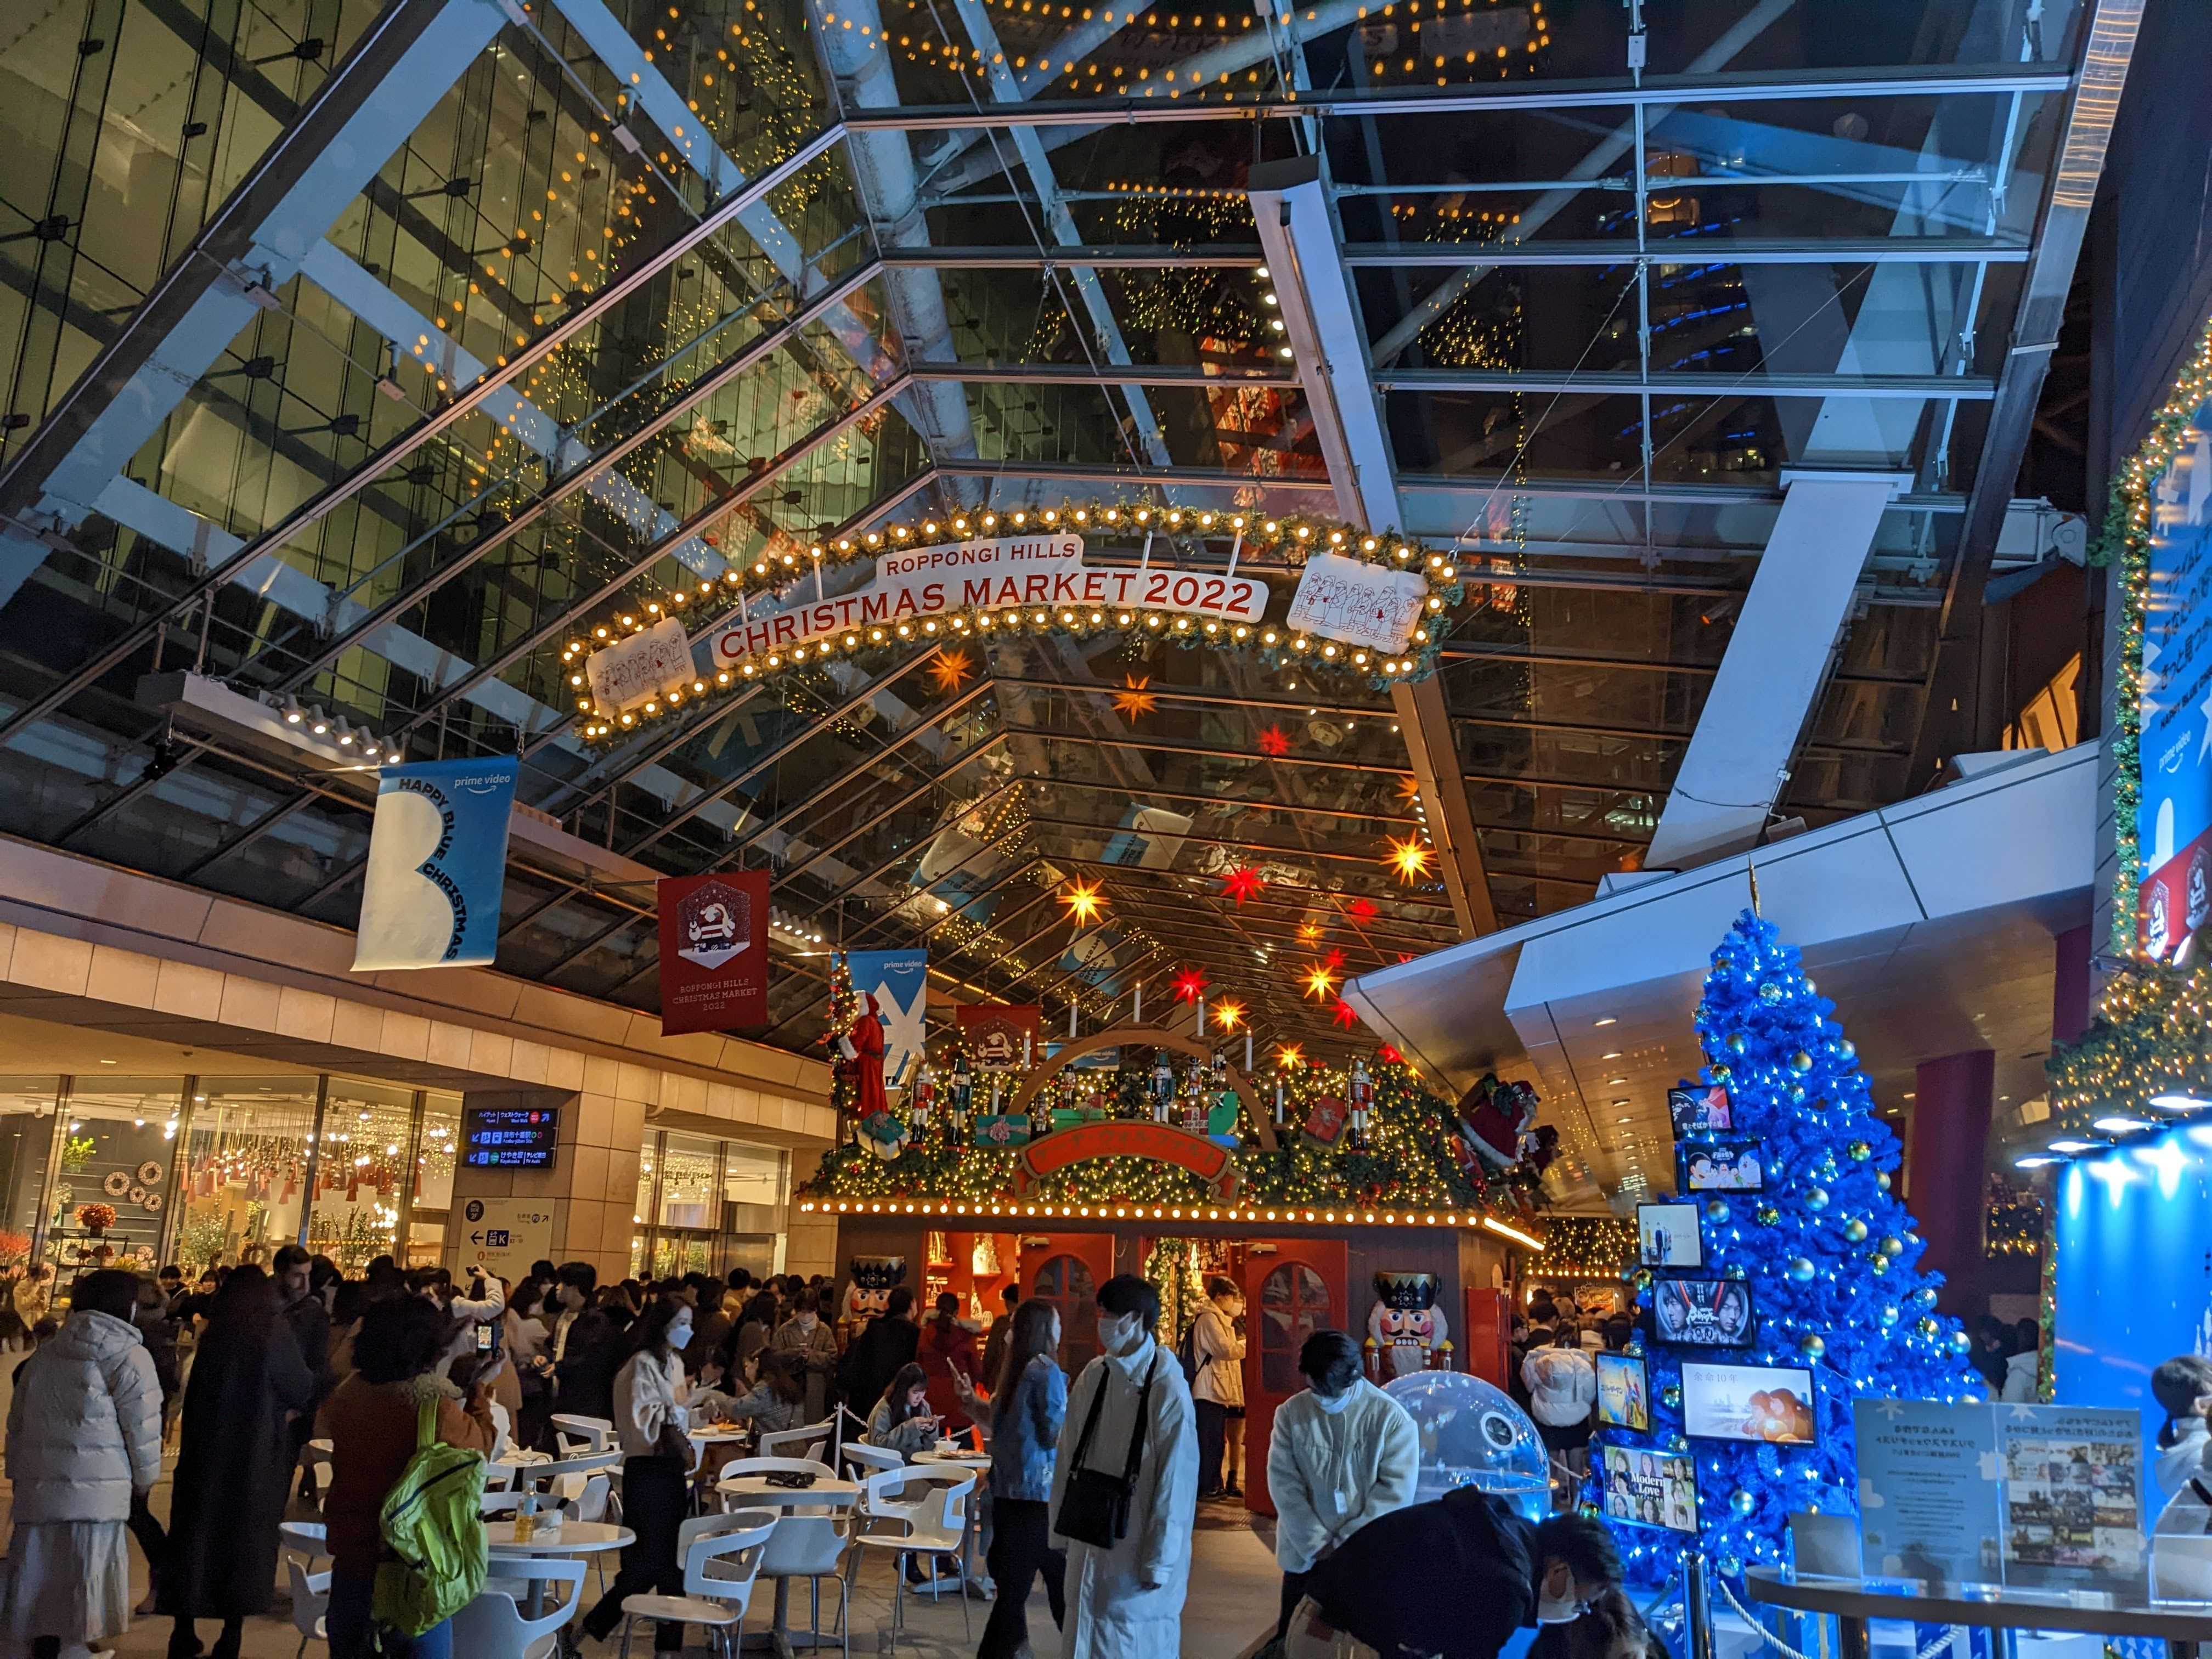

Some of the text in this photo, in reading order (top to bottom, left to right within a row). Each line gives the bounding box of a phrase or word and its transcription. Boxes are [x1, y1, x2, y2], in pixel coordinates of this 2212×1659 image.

[886, 543, 1076, 577] ROPPONGI HILLS
[720, 572, 1253, 659] CHRISTMAS MARKET 2022
[2159, 730, 2191, 772] prime video
[454, 774, 510, 788] prime video
[398, 778, 467, 961] HAPPY BLUE CHRISTMAS
[883, 961, 903, 969] prime
[680, 978, 749, 994] ROPPONGI HILLS
[673, 988, 758, 1004] CHRISTMAS MARKET
[703, 1002, 726, 1011] 2022
[499, 1234, 506, 1244] K
[1631, 1472, 1664, 1488] Modern
[1638, 1482, 1660, 1497] Love
